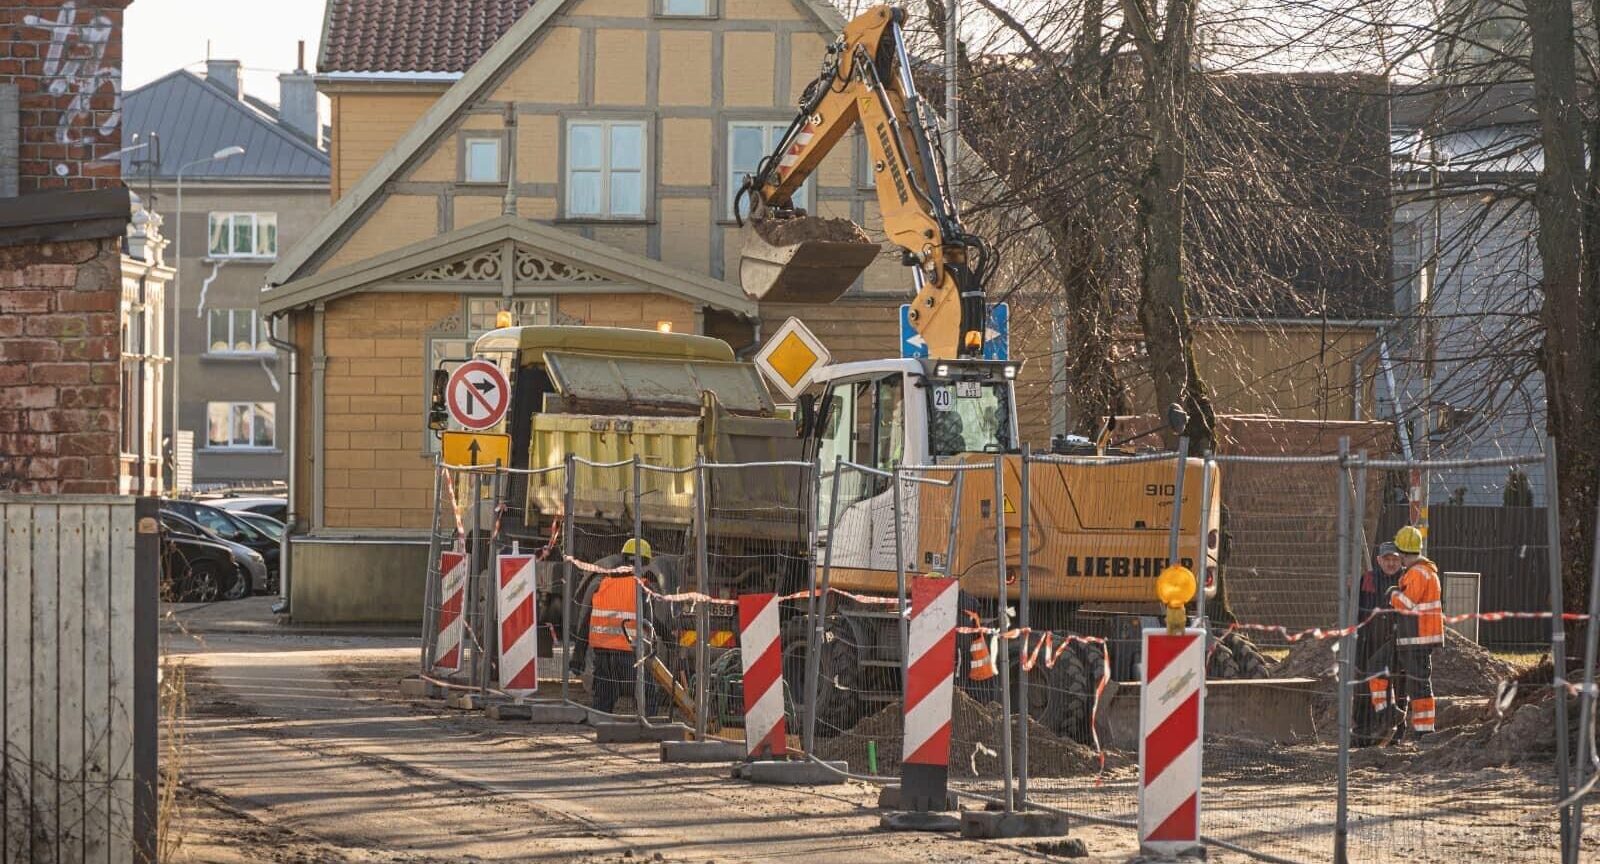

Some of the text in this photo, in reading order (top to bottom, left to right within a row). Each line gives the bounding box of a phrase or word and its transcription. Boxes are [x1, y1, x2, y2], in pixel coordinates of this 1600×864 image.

[877, 122, 908, 206] LIEBHERR
[935, 389, 949, 406] 20
[1145, 484, 1175, 496] 910
[1066, 556, 1194, 577] LIEBHER
